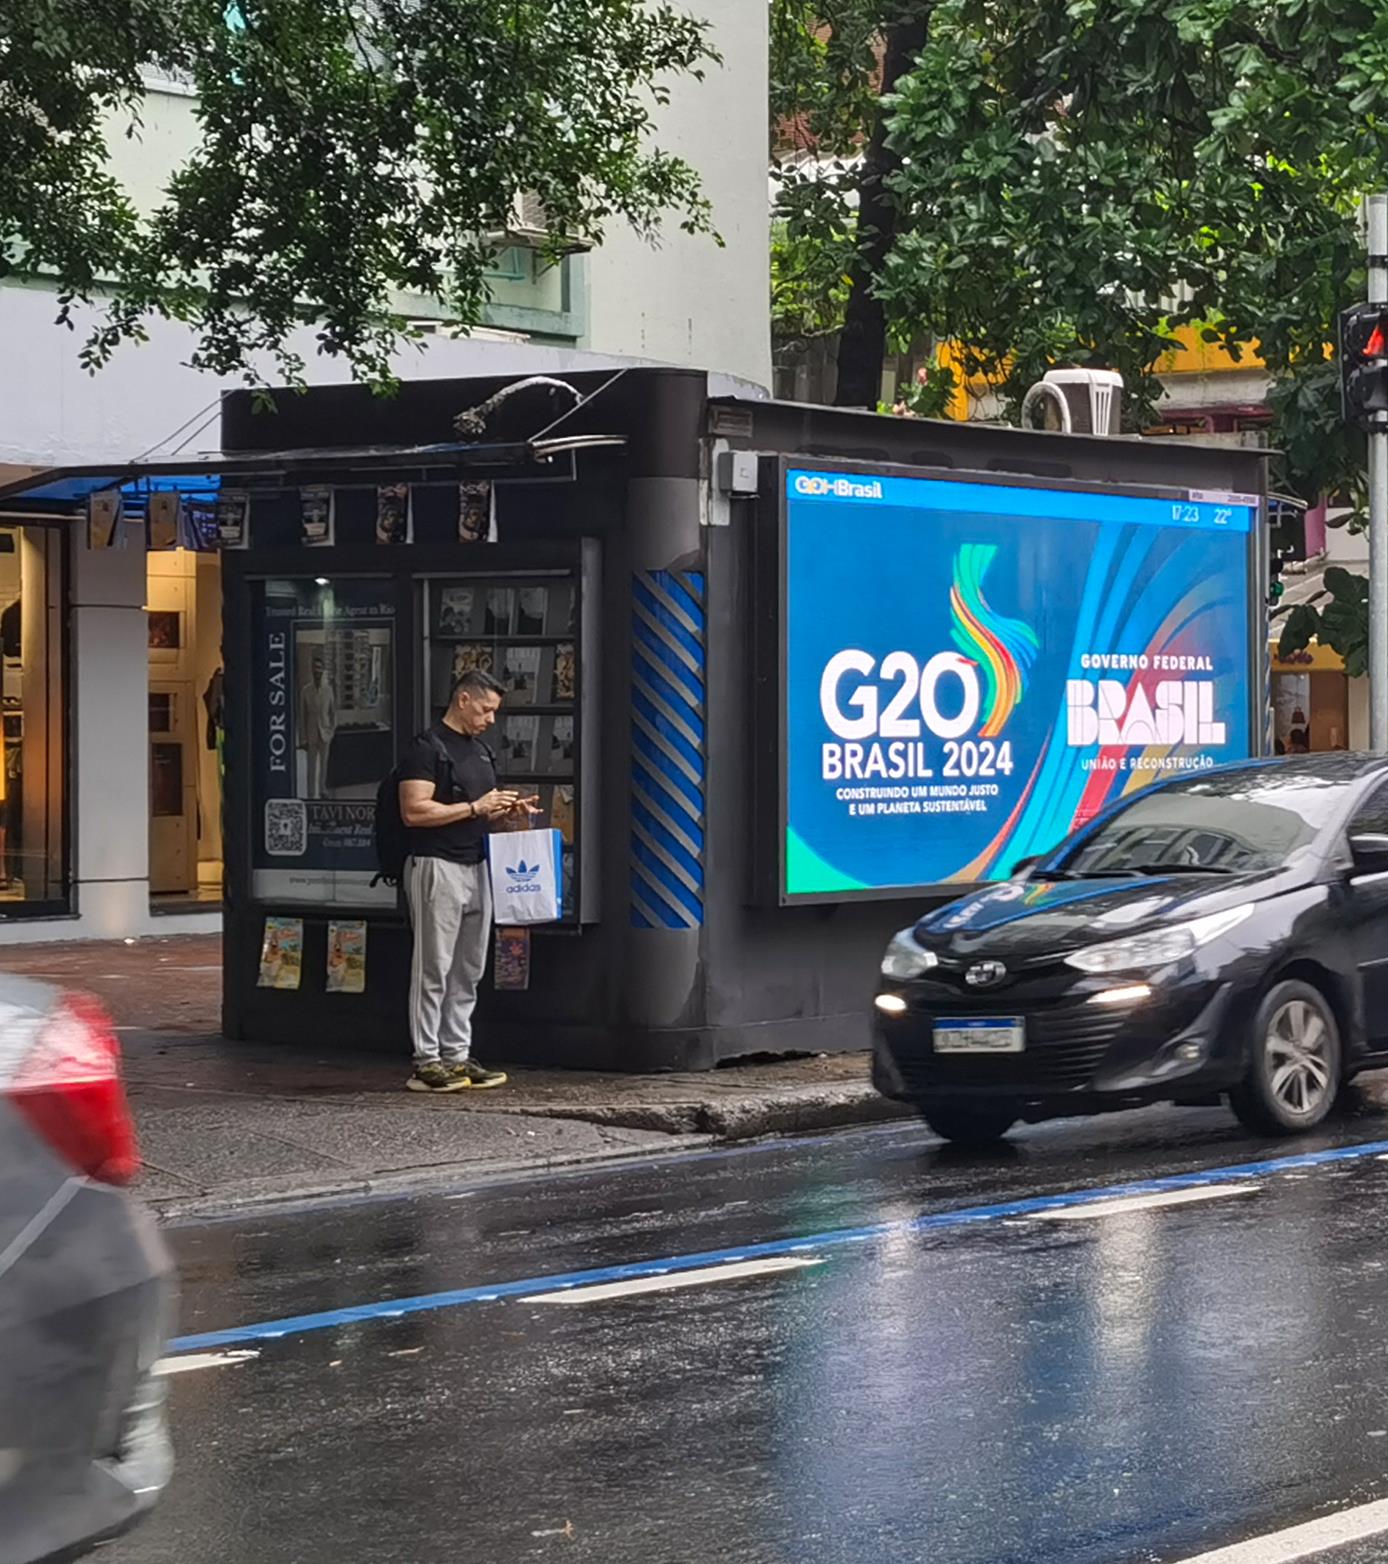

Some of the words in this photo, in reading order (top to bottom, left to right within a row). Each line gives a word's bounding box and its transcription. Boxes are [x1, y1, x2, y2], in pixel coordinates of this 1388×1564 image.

[269, 632, 286, 705] SALE
[1080, 653, 1148, 670] GOVERNO
[1153, 656, 1213, 671] FEDERAL
[820, 648, 979, 740] G20
[1066, 679, 1226, 746] BRASIL
[269, 711, 286, 772] FOR
[822, 742, 933, 780] BRASIL
[942, 740, 1014, 777] 2024
[1081, 756, 1117, 771] UNIÃO
[1119, 758, 1127, 770] E
[1130, 754, 1214, 771] RECONSTRUÇÃO
[836, 787, 909, 800] CONSTRUINDO
[911, 786, 928, 798] UM
[929, 785, 967, 798] MUNDO
[968, 784, 999, 797] JUSTO
[849, 804, 857, 816] E
[858, 803, 876, 816] UM
[877, 801, 921, 815] PLANETA
[923, 799, 988, 813] SUSTENTÁVEL
[506, 883, 541, 894] adidas
